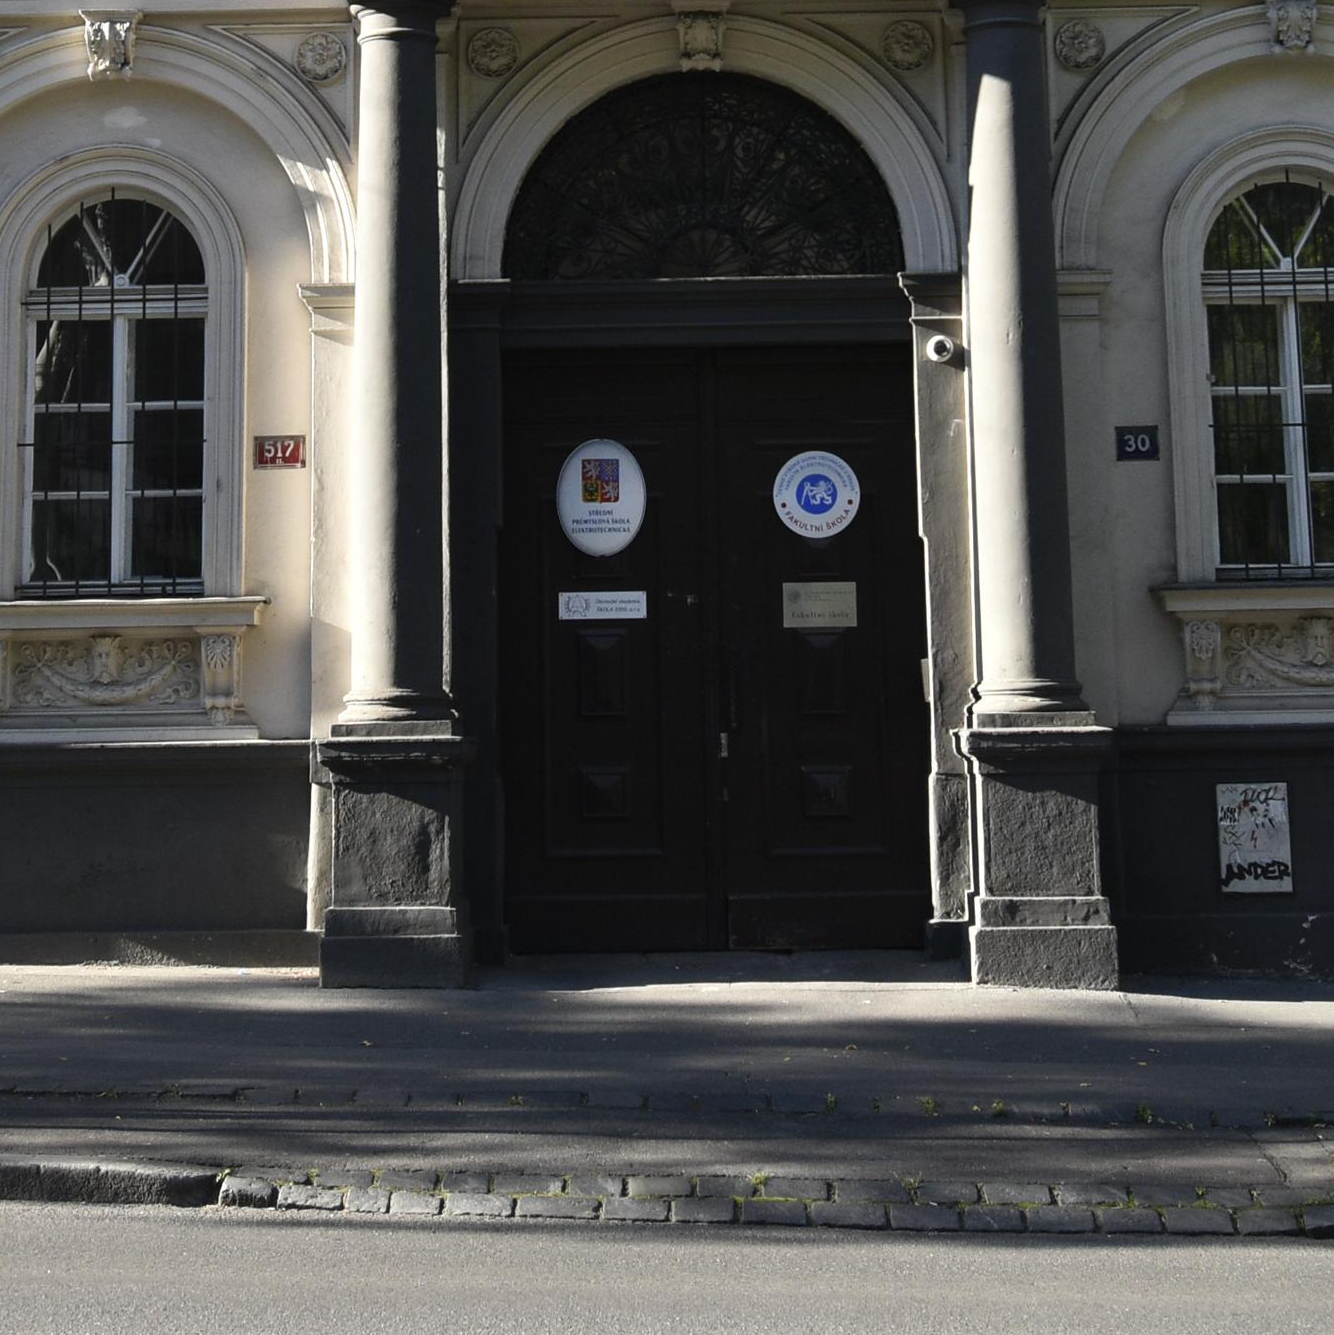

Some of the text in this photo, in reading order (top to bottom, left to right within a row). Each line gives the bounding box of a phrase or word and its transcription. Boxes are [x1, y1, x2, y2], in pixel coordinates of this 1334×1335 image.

[264, 440, 295, 458] 517
[1124, 434, 1151, 452] 30
[784, 509, 851, 532] FAKULTNÍ ŠKOLA
